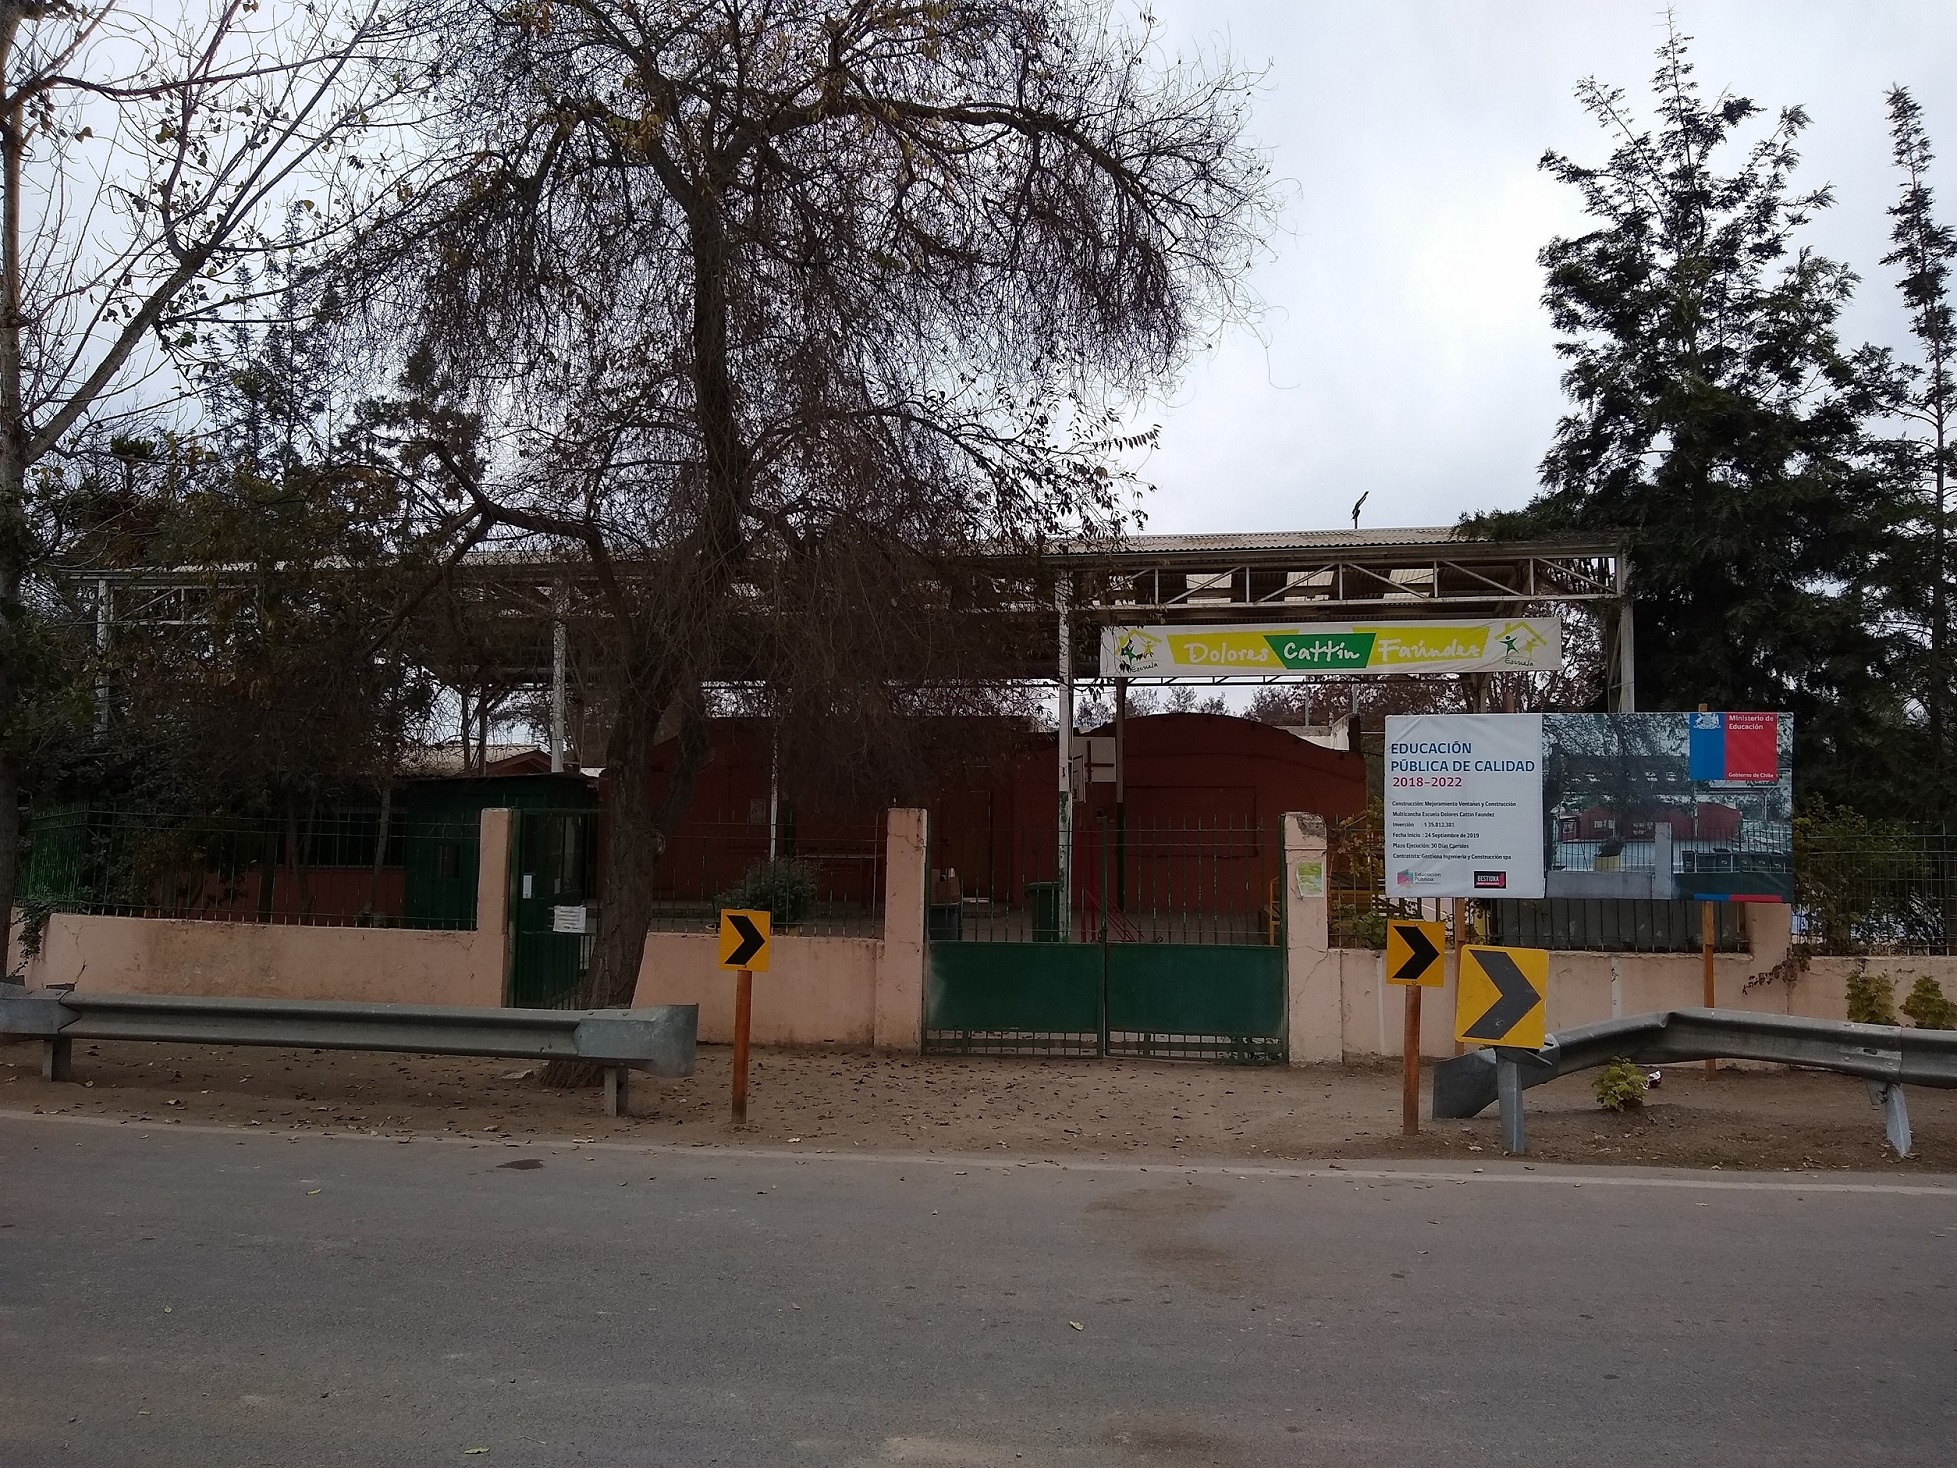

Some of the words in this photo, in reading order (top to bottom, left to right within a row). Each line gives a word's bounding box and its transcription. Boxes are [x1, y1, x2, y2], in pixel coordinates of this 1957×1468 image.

[1183, 642, 1269, 664] Dolores
[1728, 714, 1764, 722] Ministerio
[1765, 714, 1774, 722] de
[1391, 741, 1472, 754] EDUCACIÓN
[1391, 758, 1449, 772] PÚBLICA
[1452, 760, 1471, 772] DE
[1474, 760, 1535, 772] CALIDAD
[1392, 777, 1462, 787] 2018-2022
[1424, 800, 1459, 808] Mejoramiento
[1432, 832, 1460, 840] Septiembre
